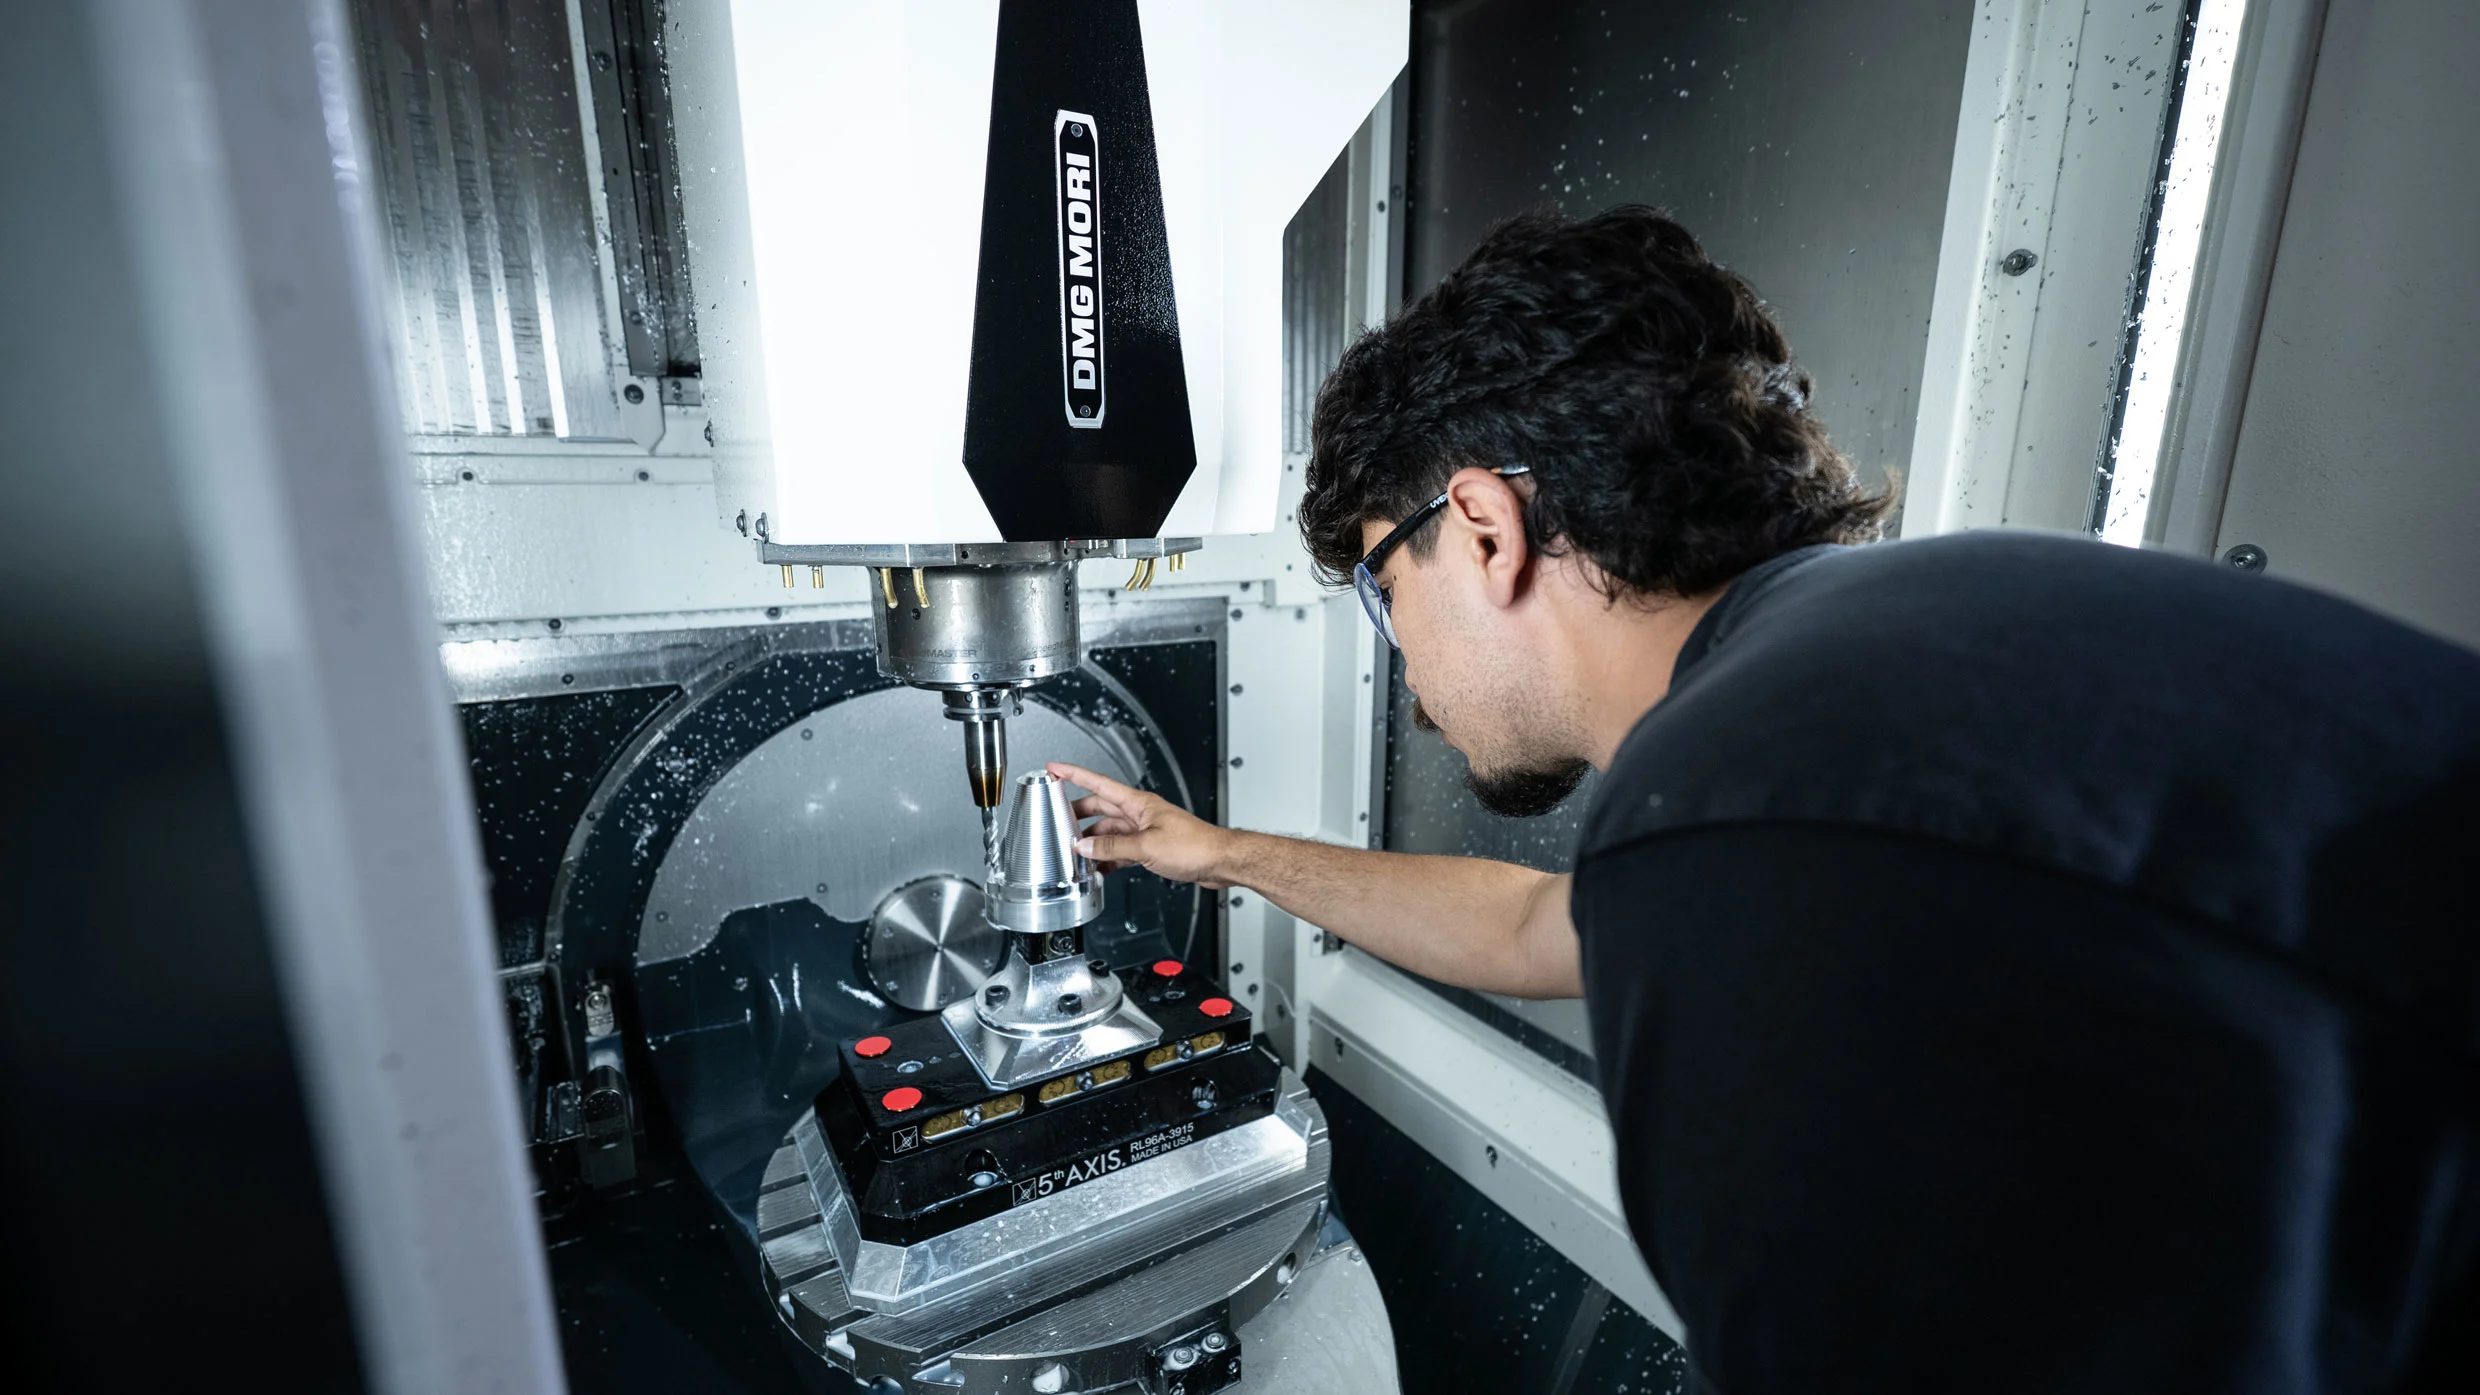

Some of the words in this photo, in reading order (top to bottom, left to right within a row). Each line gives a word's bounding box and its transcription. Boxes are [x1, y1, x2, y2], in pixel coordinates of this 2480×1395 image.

[1066, 152, 1093, 278] MORI
[1071, 284, 1096, 390] DMG
[1130, 1122, 1194, 1152] RL96A-3915
[1131, 1145, 1159, 1163] MADE
[1161, 1141, 1171, 1152] IN
[1173, 1134, 1192, 1147] USA
